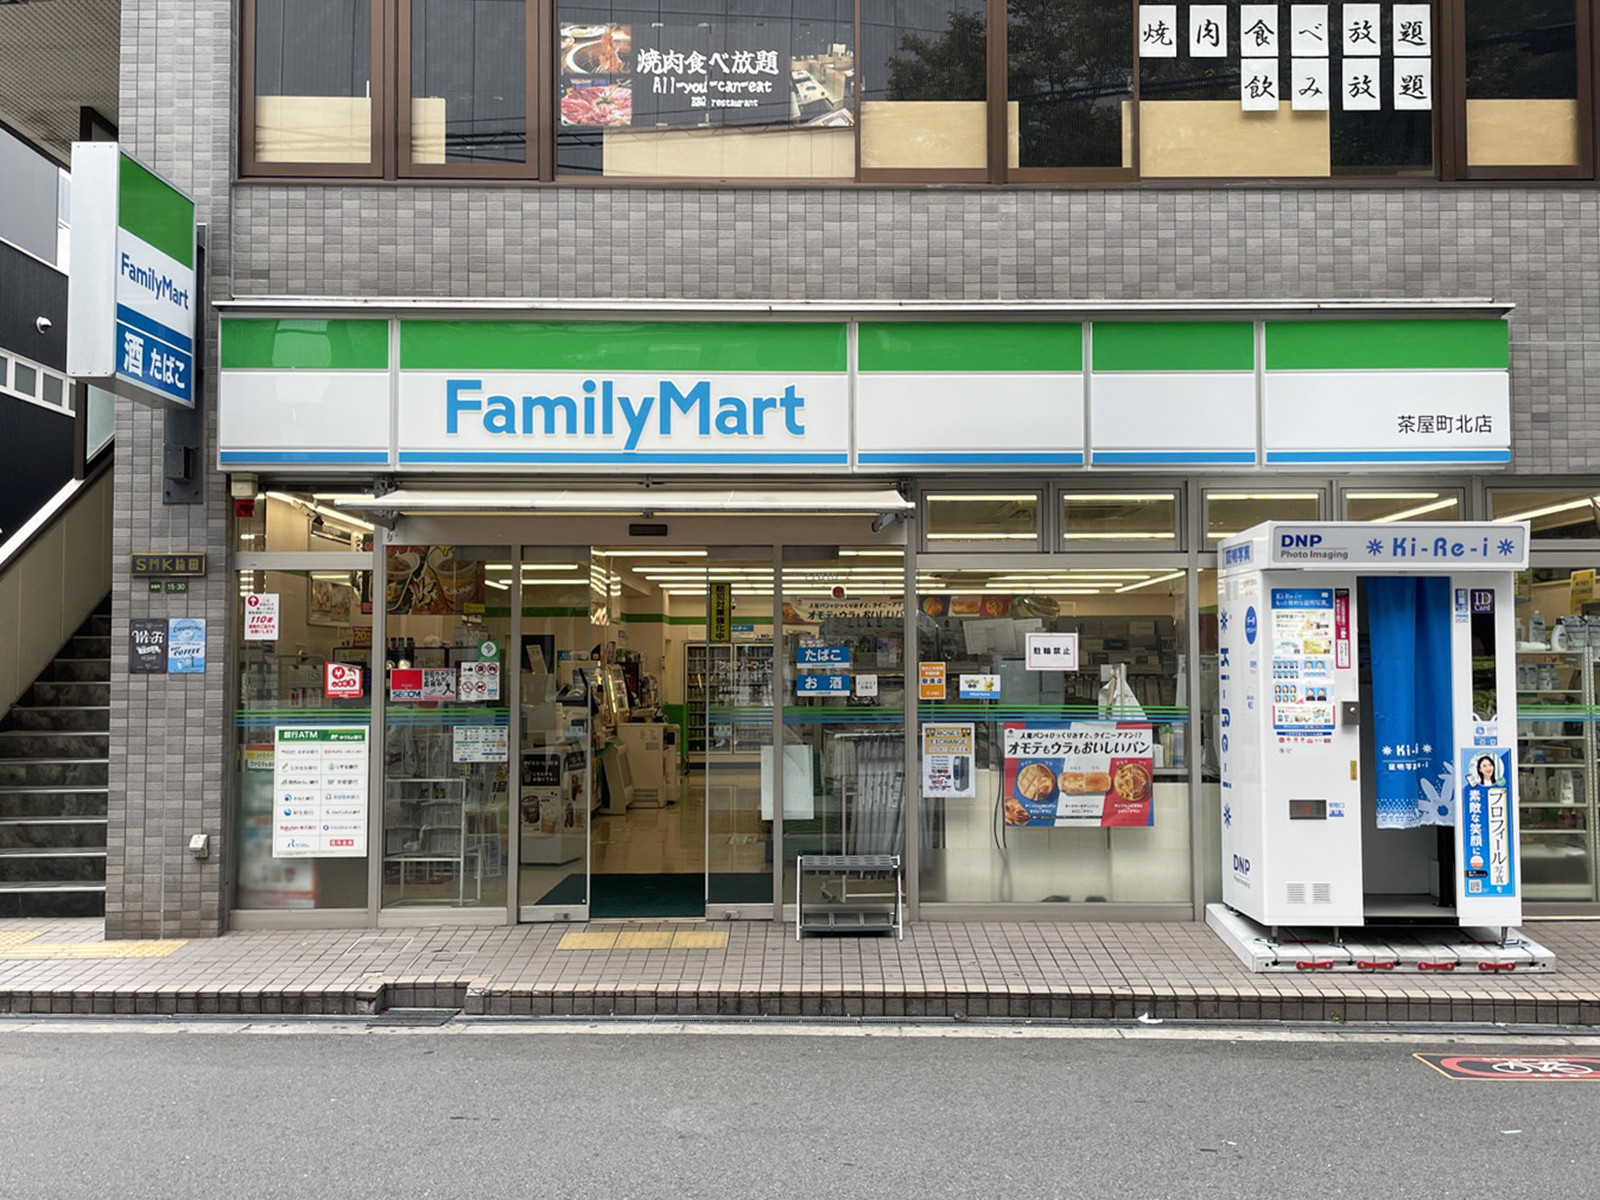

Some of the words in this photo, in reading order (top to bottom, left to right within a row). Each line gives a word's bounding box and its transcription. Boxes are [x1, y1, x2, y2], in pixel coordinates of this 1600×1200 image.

[1143, 18, 1428, 48] 焼肉食べ放題
[636, 49, 779, 76] 焼肉食べ放題
[653, 76, 773, 95] All-you-can-eat
[1244, 74, 1428, 100] 飲み放題
[711, 97, 759, 107] restaurant
[121, 252, 190, 311] FamilyMart
[123, 331, 144, 378] 酒
[150, 347, 186, 389] たばこ
[446, 379, 805, 451] FamilyMart
[1397, 414, 1492, 434] 茶屋町北店
[1281, 534, 1322, 547] DNP
[1392, 536, 1488, 557] Ki-Re-i
[1280, 549, 1308, 559] Photo
[1309, 549, 1349, 560] Imaging
[1475, 592, 1492, 605] ID
[805, 649, 842, 661] たばこ
[1033, 647, 1071, 655] 駐輪禁止
[1008, 741, 1150, 755] オモテもウラもおいしいパン
[1233, 853, 1251, 875] DNP
